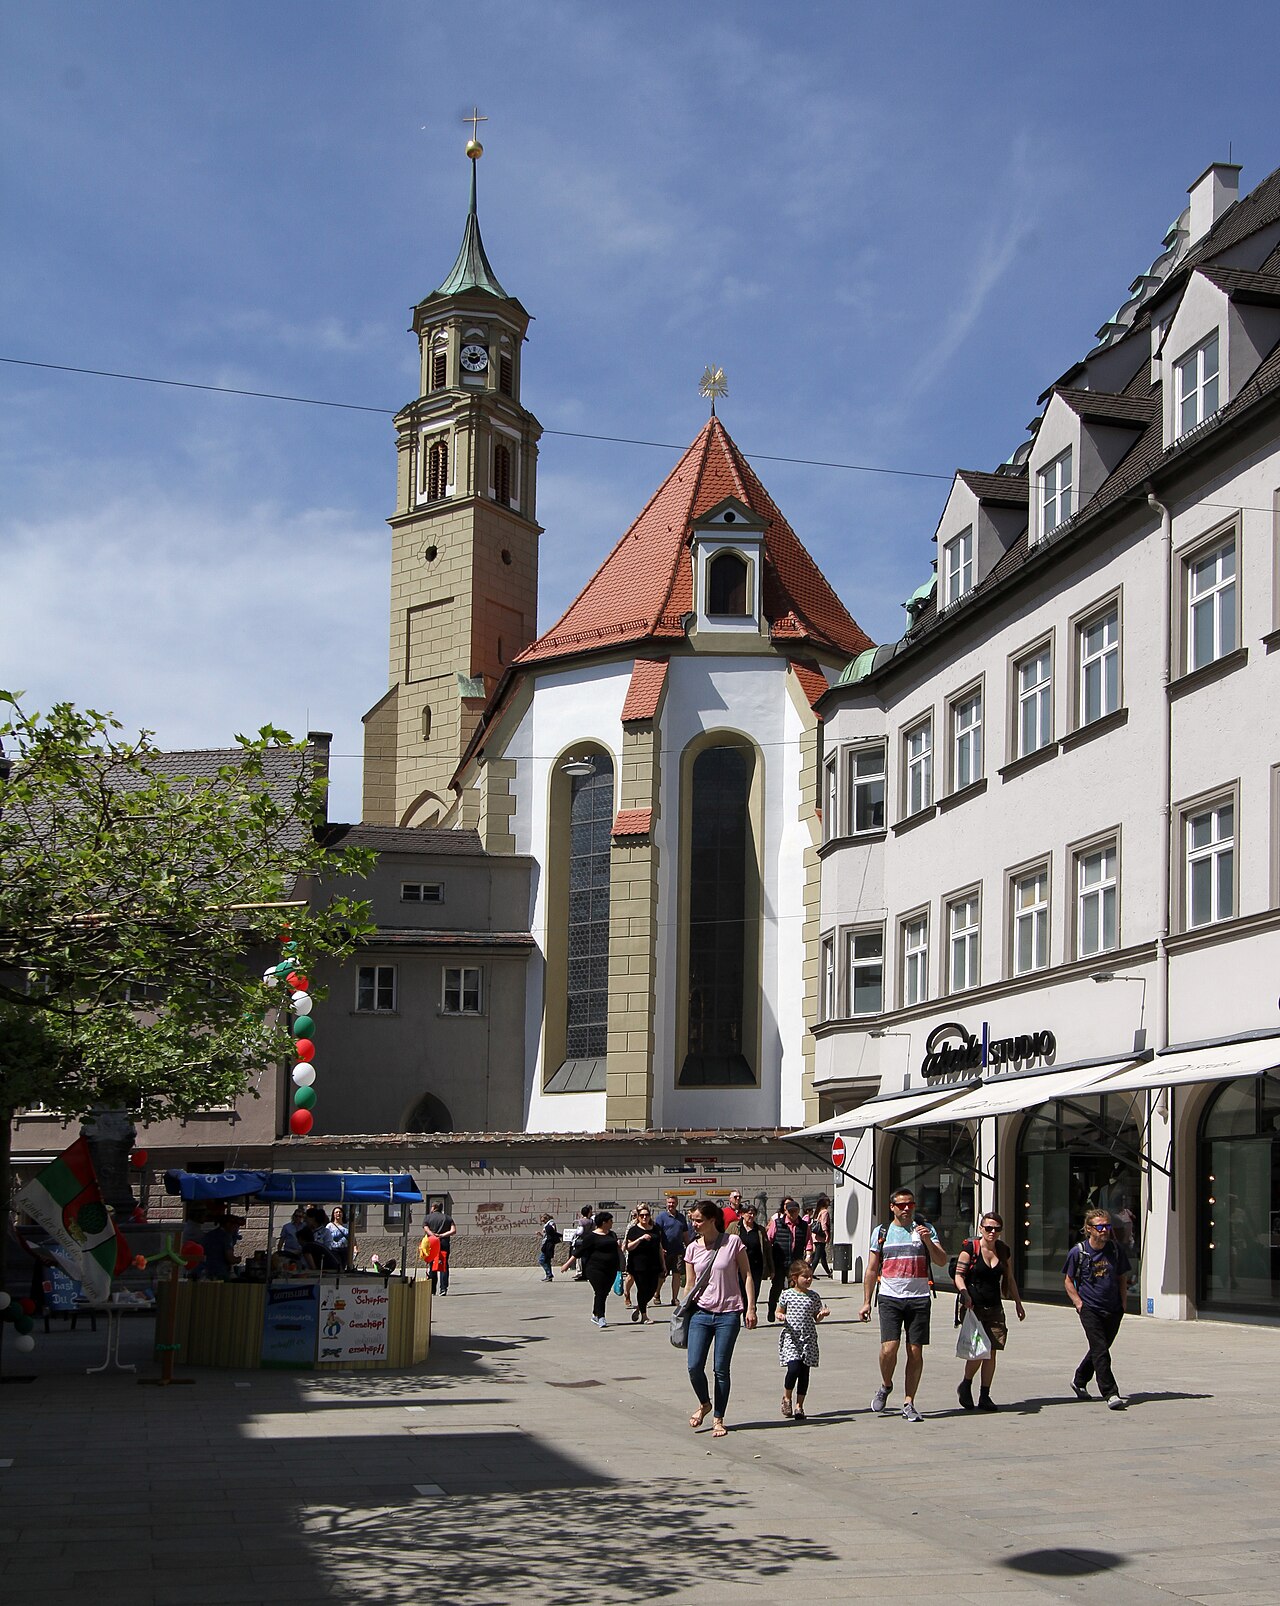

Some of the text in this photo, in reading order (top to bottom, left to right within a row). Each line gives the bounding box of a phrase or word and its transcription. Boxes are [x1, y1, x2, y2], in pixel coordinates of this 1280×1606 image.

[988, 1030, 1055, 1066] STUDIO
[54, 1280, 74, 1291] hast
[51, 1293, 68, 1304] Du
[355, 1295, 388, 1306] Schöpfer
[349, 1317, 386, 1330] Geschöpf
[348, 1344, 384, 1356] erschöpft
